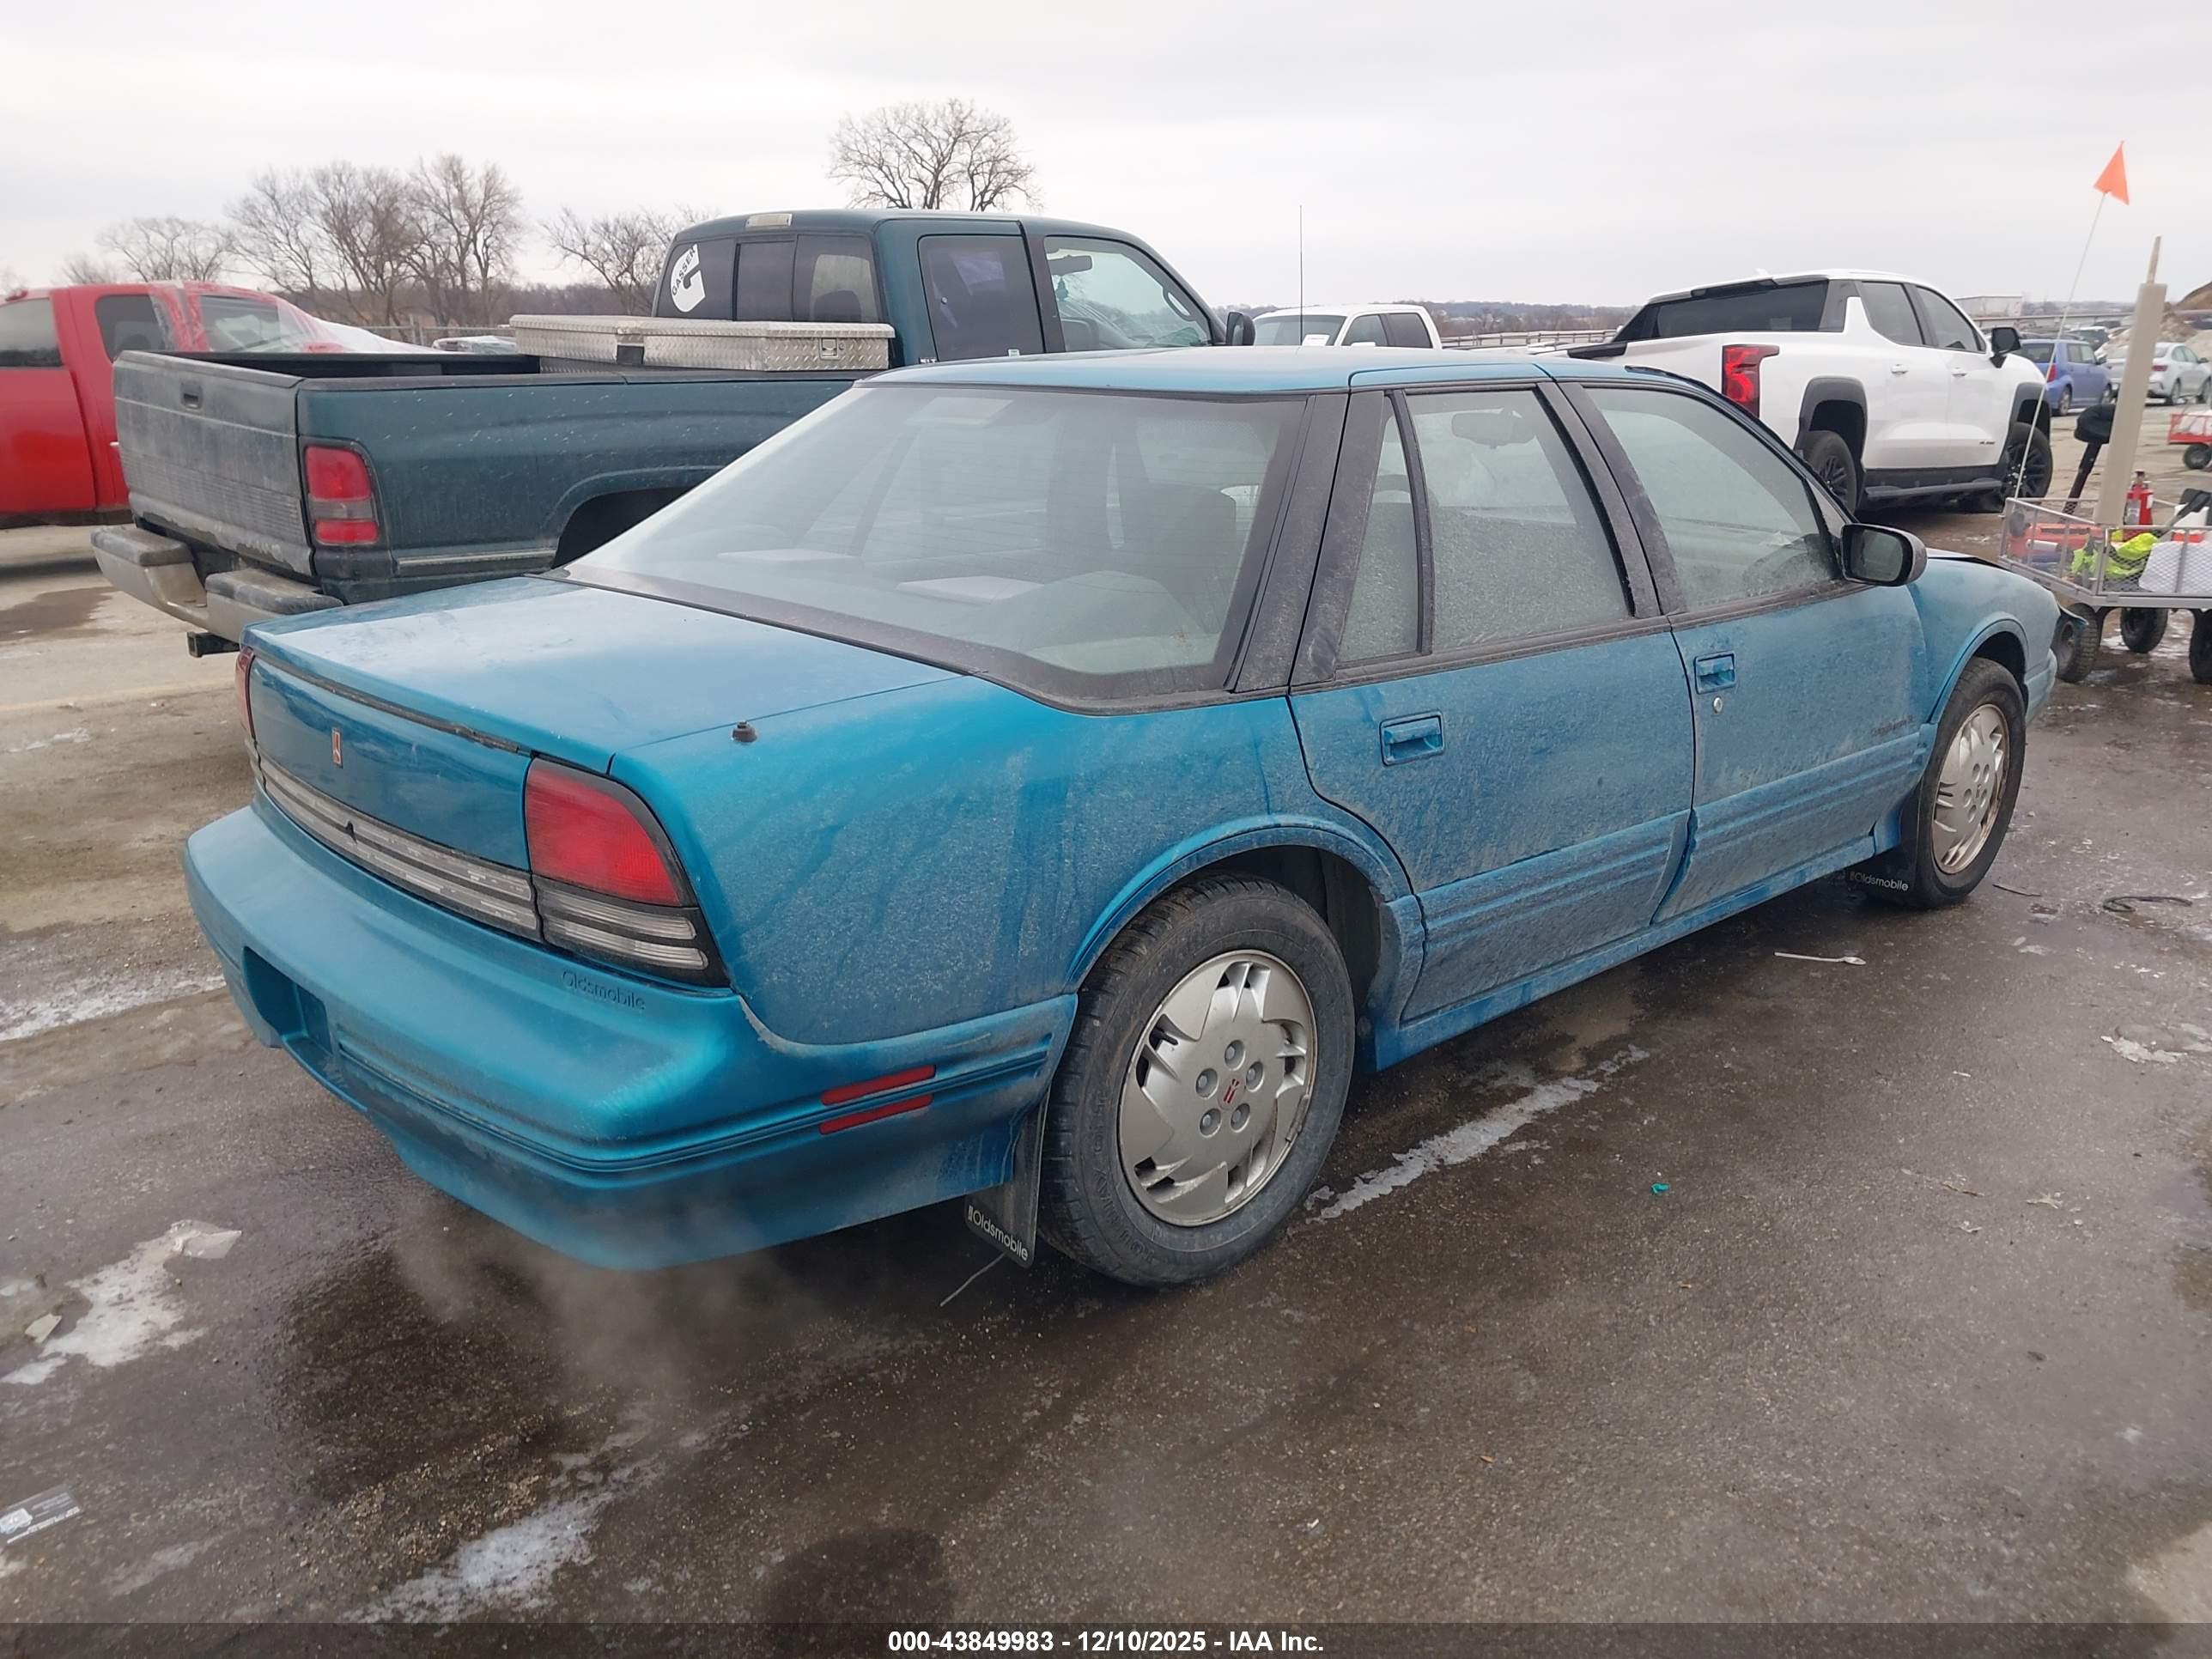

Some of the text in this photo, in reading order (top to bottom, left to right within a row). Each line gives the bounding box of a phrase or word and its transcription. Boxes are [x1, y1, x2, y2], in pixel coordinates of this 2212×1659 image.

[1855, 872, 1909, 891] Oldsmobile
[562, 969, 646, 1011] Oldsmobile
[973, 1209, 1029, 1261] Oldsmobile
